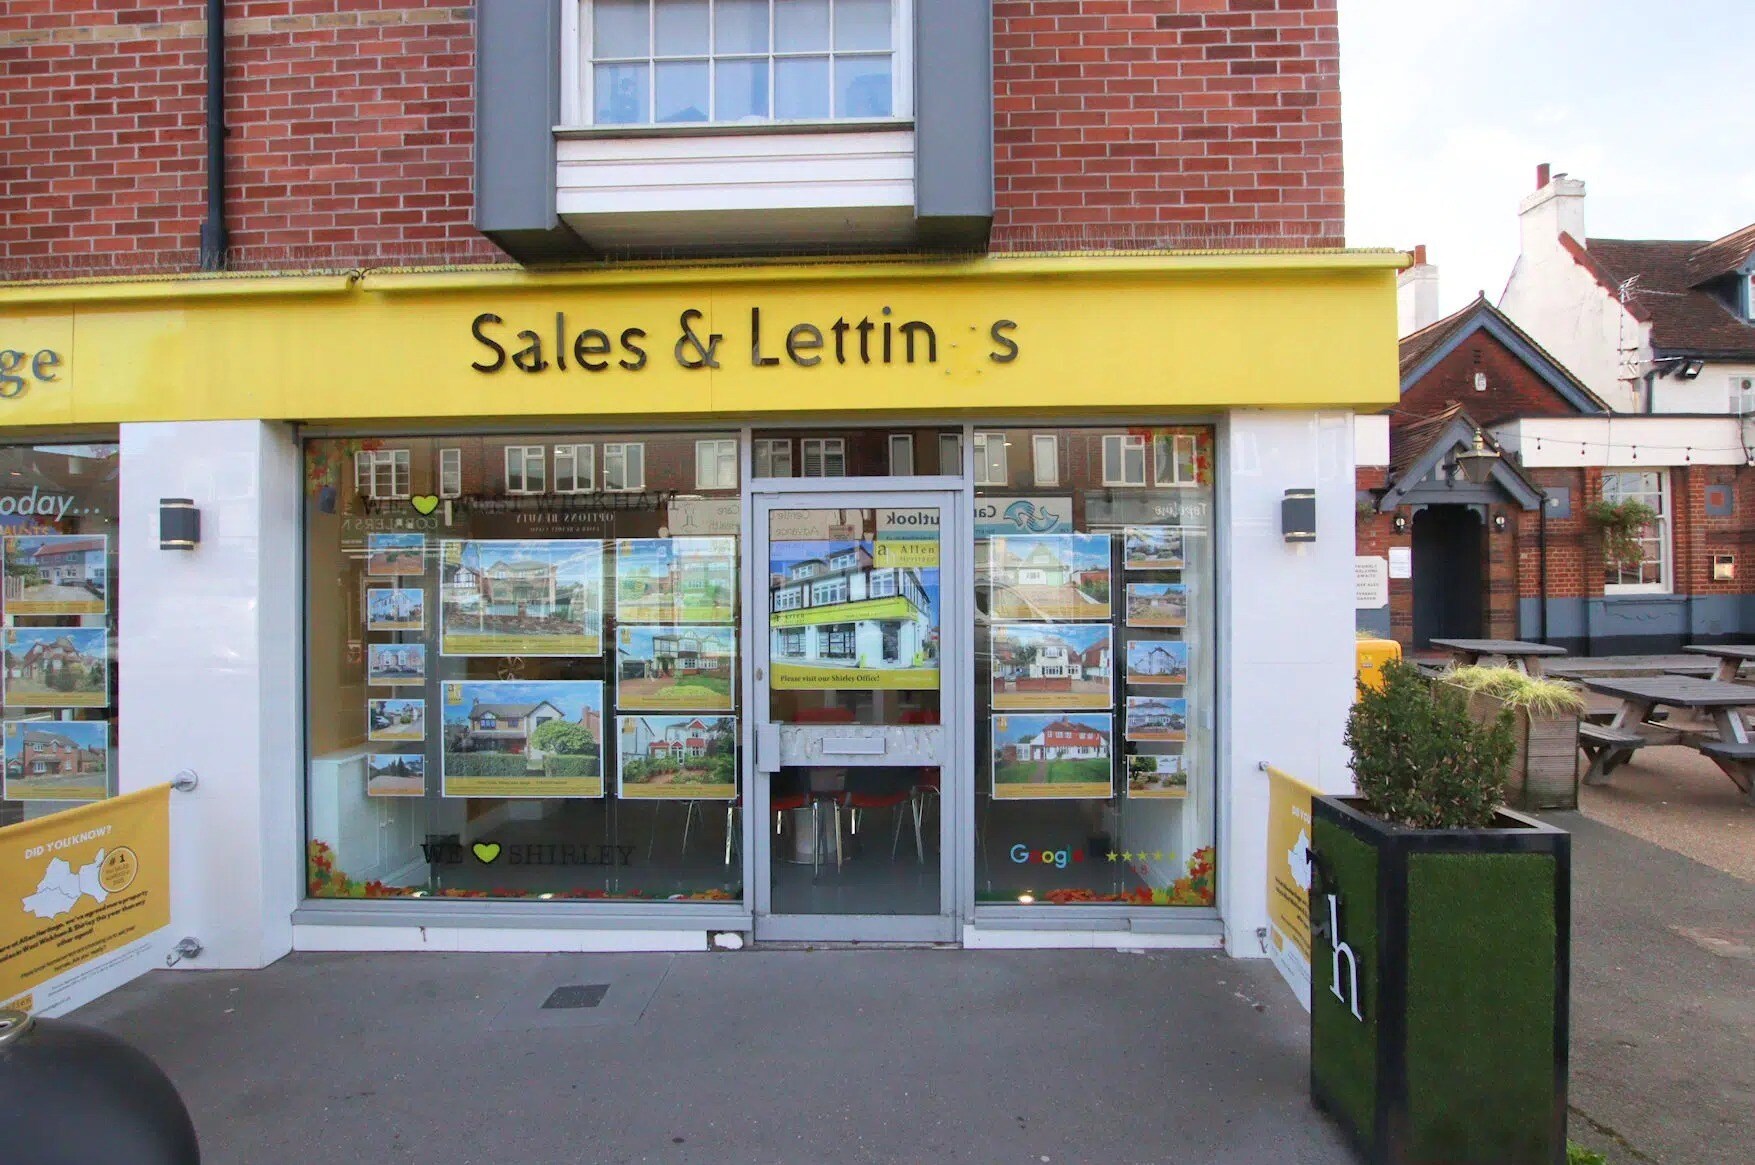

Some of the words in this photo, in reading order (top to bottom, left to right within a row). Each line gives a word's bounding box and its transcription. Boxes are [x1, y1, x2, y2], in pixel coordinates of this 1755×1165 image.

[471, 311, 647, 373] Sales
[674, 308, 723, 370] &
[900, 543, 936, 553] Allen
[780, 674, 801, 682] Please
[801, 674, 817, 682] visit
[831, 674, 855, 684] Shirley
[856, 674, 880, 682] Office!
[25, 845, 44, 859] DID
[46, 836, 71, 852] YOU
[71, 824, 112, 845] KNOW?
[508, 844, 637, 865] SHIRLEY
[1010, 844, 1084, 868] Google
